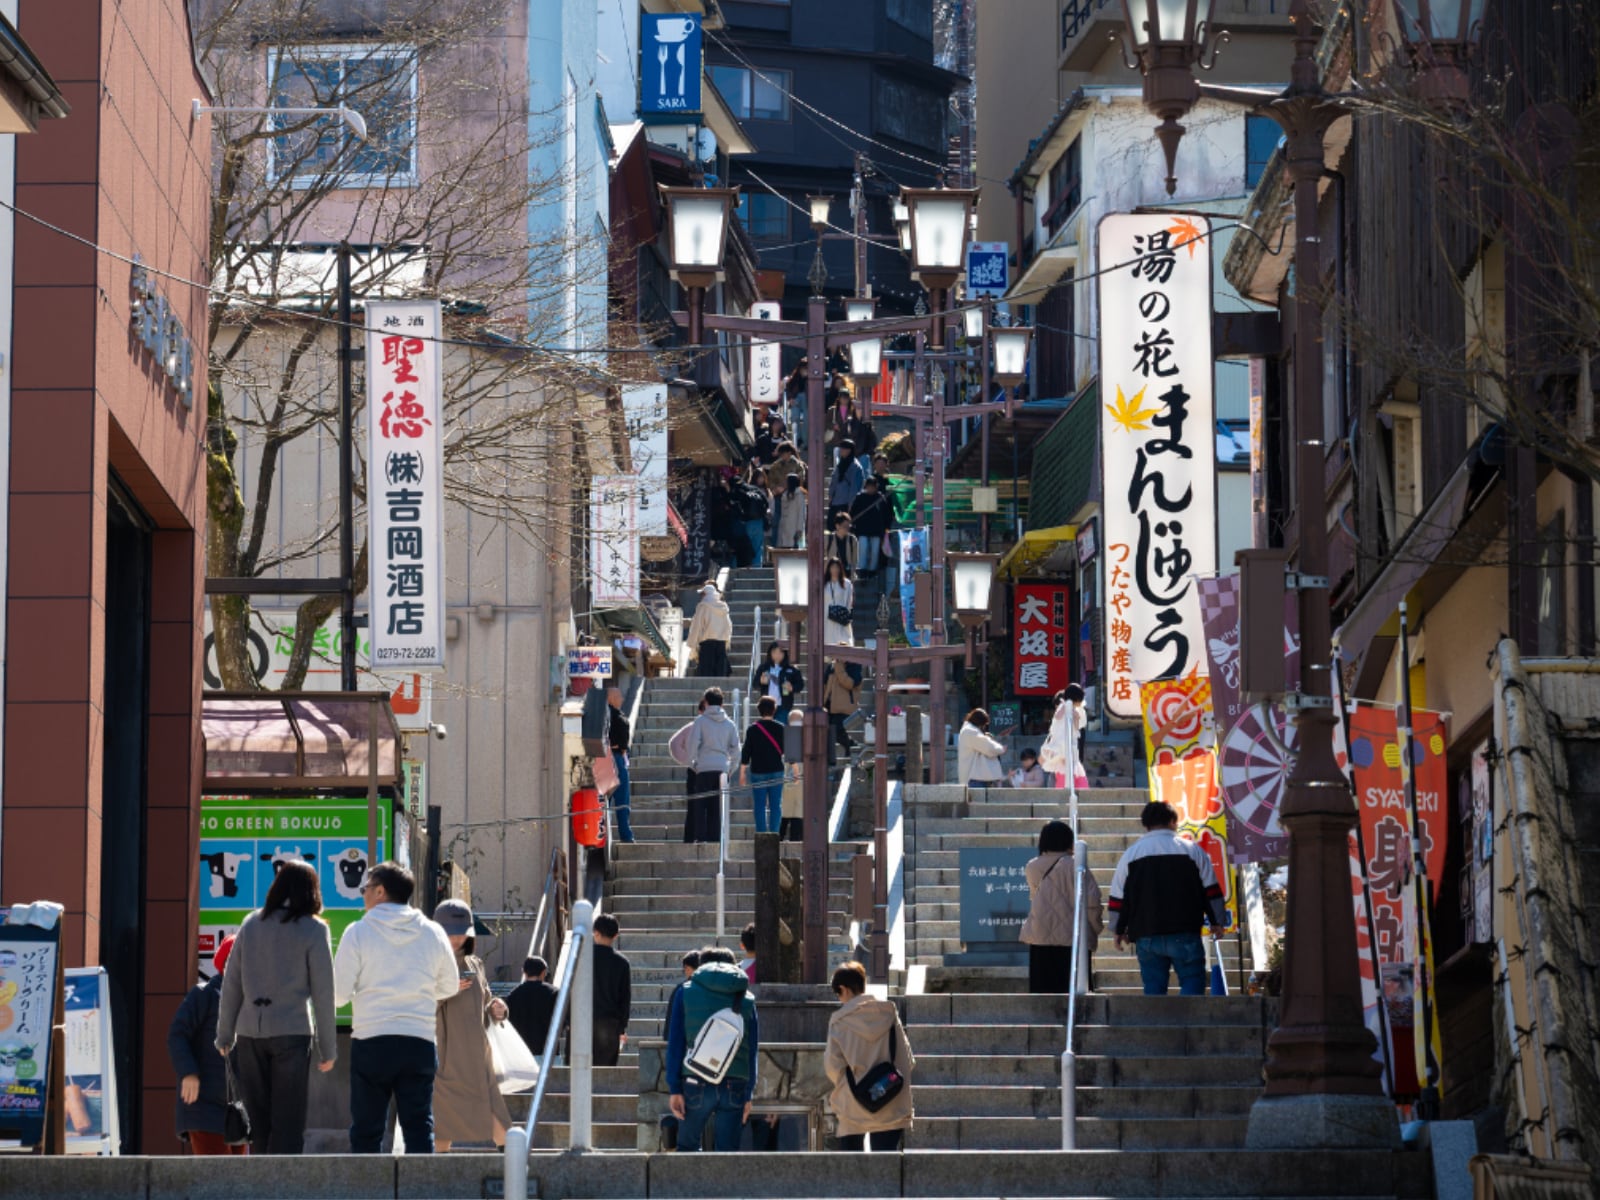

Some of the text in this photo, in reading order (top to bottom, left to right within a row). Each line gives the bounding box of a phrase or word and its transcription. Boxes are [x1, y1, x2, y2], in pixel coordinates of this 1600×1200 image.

[657, 97, 687, 109] SARA
[383, 315, 424, 327] 地酒
[379, 334, 433, 439] 聖徳
[1128, 229, 1193, 683] 湯の花まんじゅう
[1108, 542, 1133, 701] つたや物産店
[377, 647, 436, 659] 0279-72-2292
[224, 817, 274, 829] GREEN
[16, 952, 36, 1035] ソフトクリーム
